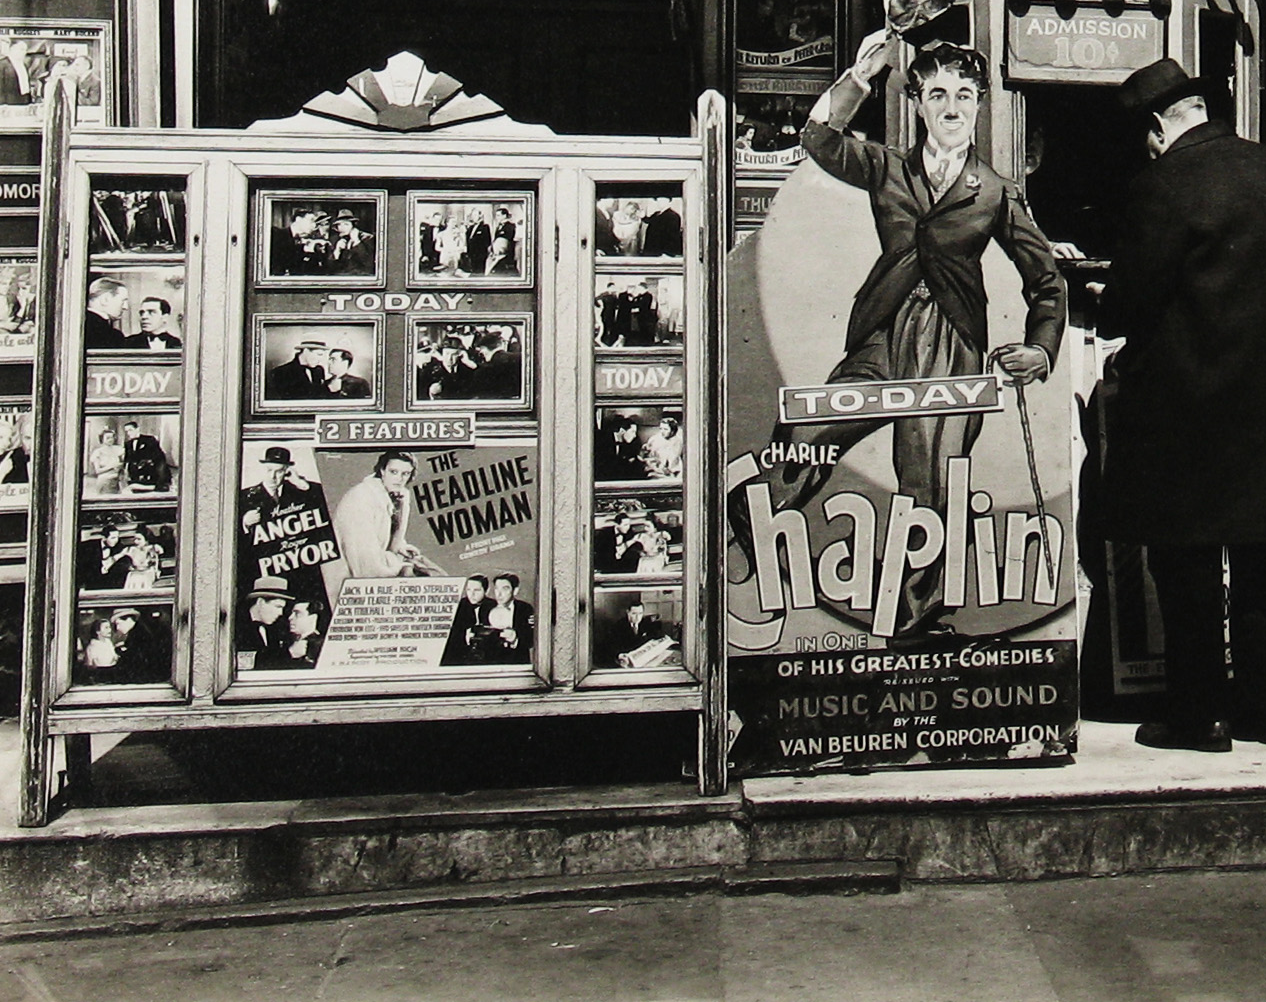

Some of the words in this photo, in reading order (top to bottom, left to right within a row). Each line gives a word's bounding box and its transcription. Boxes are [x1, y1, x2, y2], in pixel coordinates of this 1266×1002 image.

[1026, 18, 1148, 39] ADMISSION
[1052, 36, 1120, 70] 10¢
[329, 293, 464, 312] TODAY
[91, 372, 173, 394] TODAY
[602, 366, 675, 390] TODAY
[794, 380, 989, 415] TO-DAY
[326, 422, 340, 440] 2
[350, 421, 465, 440] FEATURES
[427, 451, 460, 474] THE
[760, 442, 840, 469] CHARLIE
[413, 455, 534, 515] HEADLINE
[252, 509, 330, 546] ANGEL
[427, 491, 533, 546] WOMAN
[258, 539, 338, 576] PRYOR
[727, 451, 1065, 651] Chaplin
[365, 586, 375, 595] LA
[795, 635, 818, 653] IN
[821, 632, 869, 651] ONE
[777, 660, 805, 677] OF
[811, 657, 844, 675] HIS
[778, 694, 868, 720] MUSIC
[877, 690, 938, 714] AND
[951, 684, 1058, 710] SOUND
[893, 717, 910, 728] BY
[914, 715, 937, 726] THE
[780, 737, 823, 757] VAN
[829, 731, 908, 754] BEUREN
[916, 725, 1060, 749] CORPORATION
